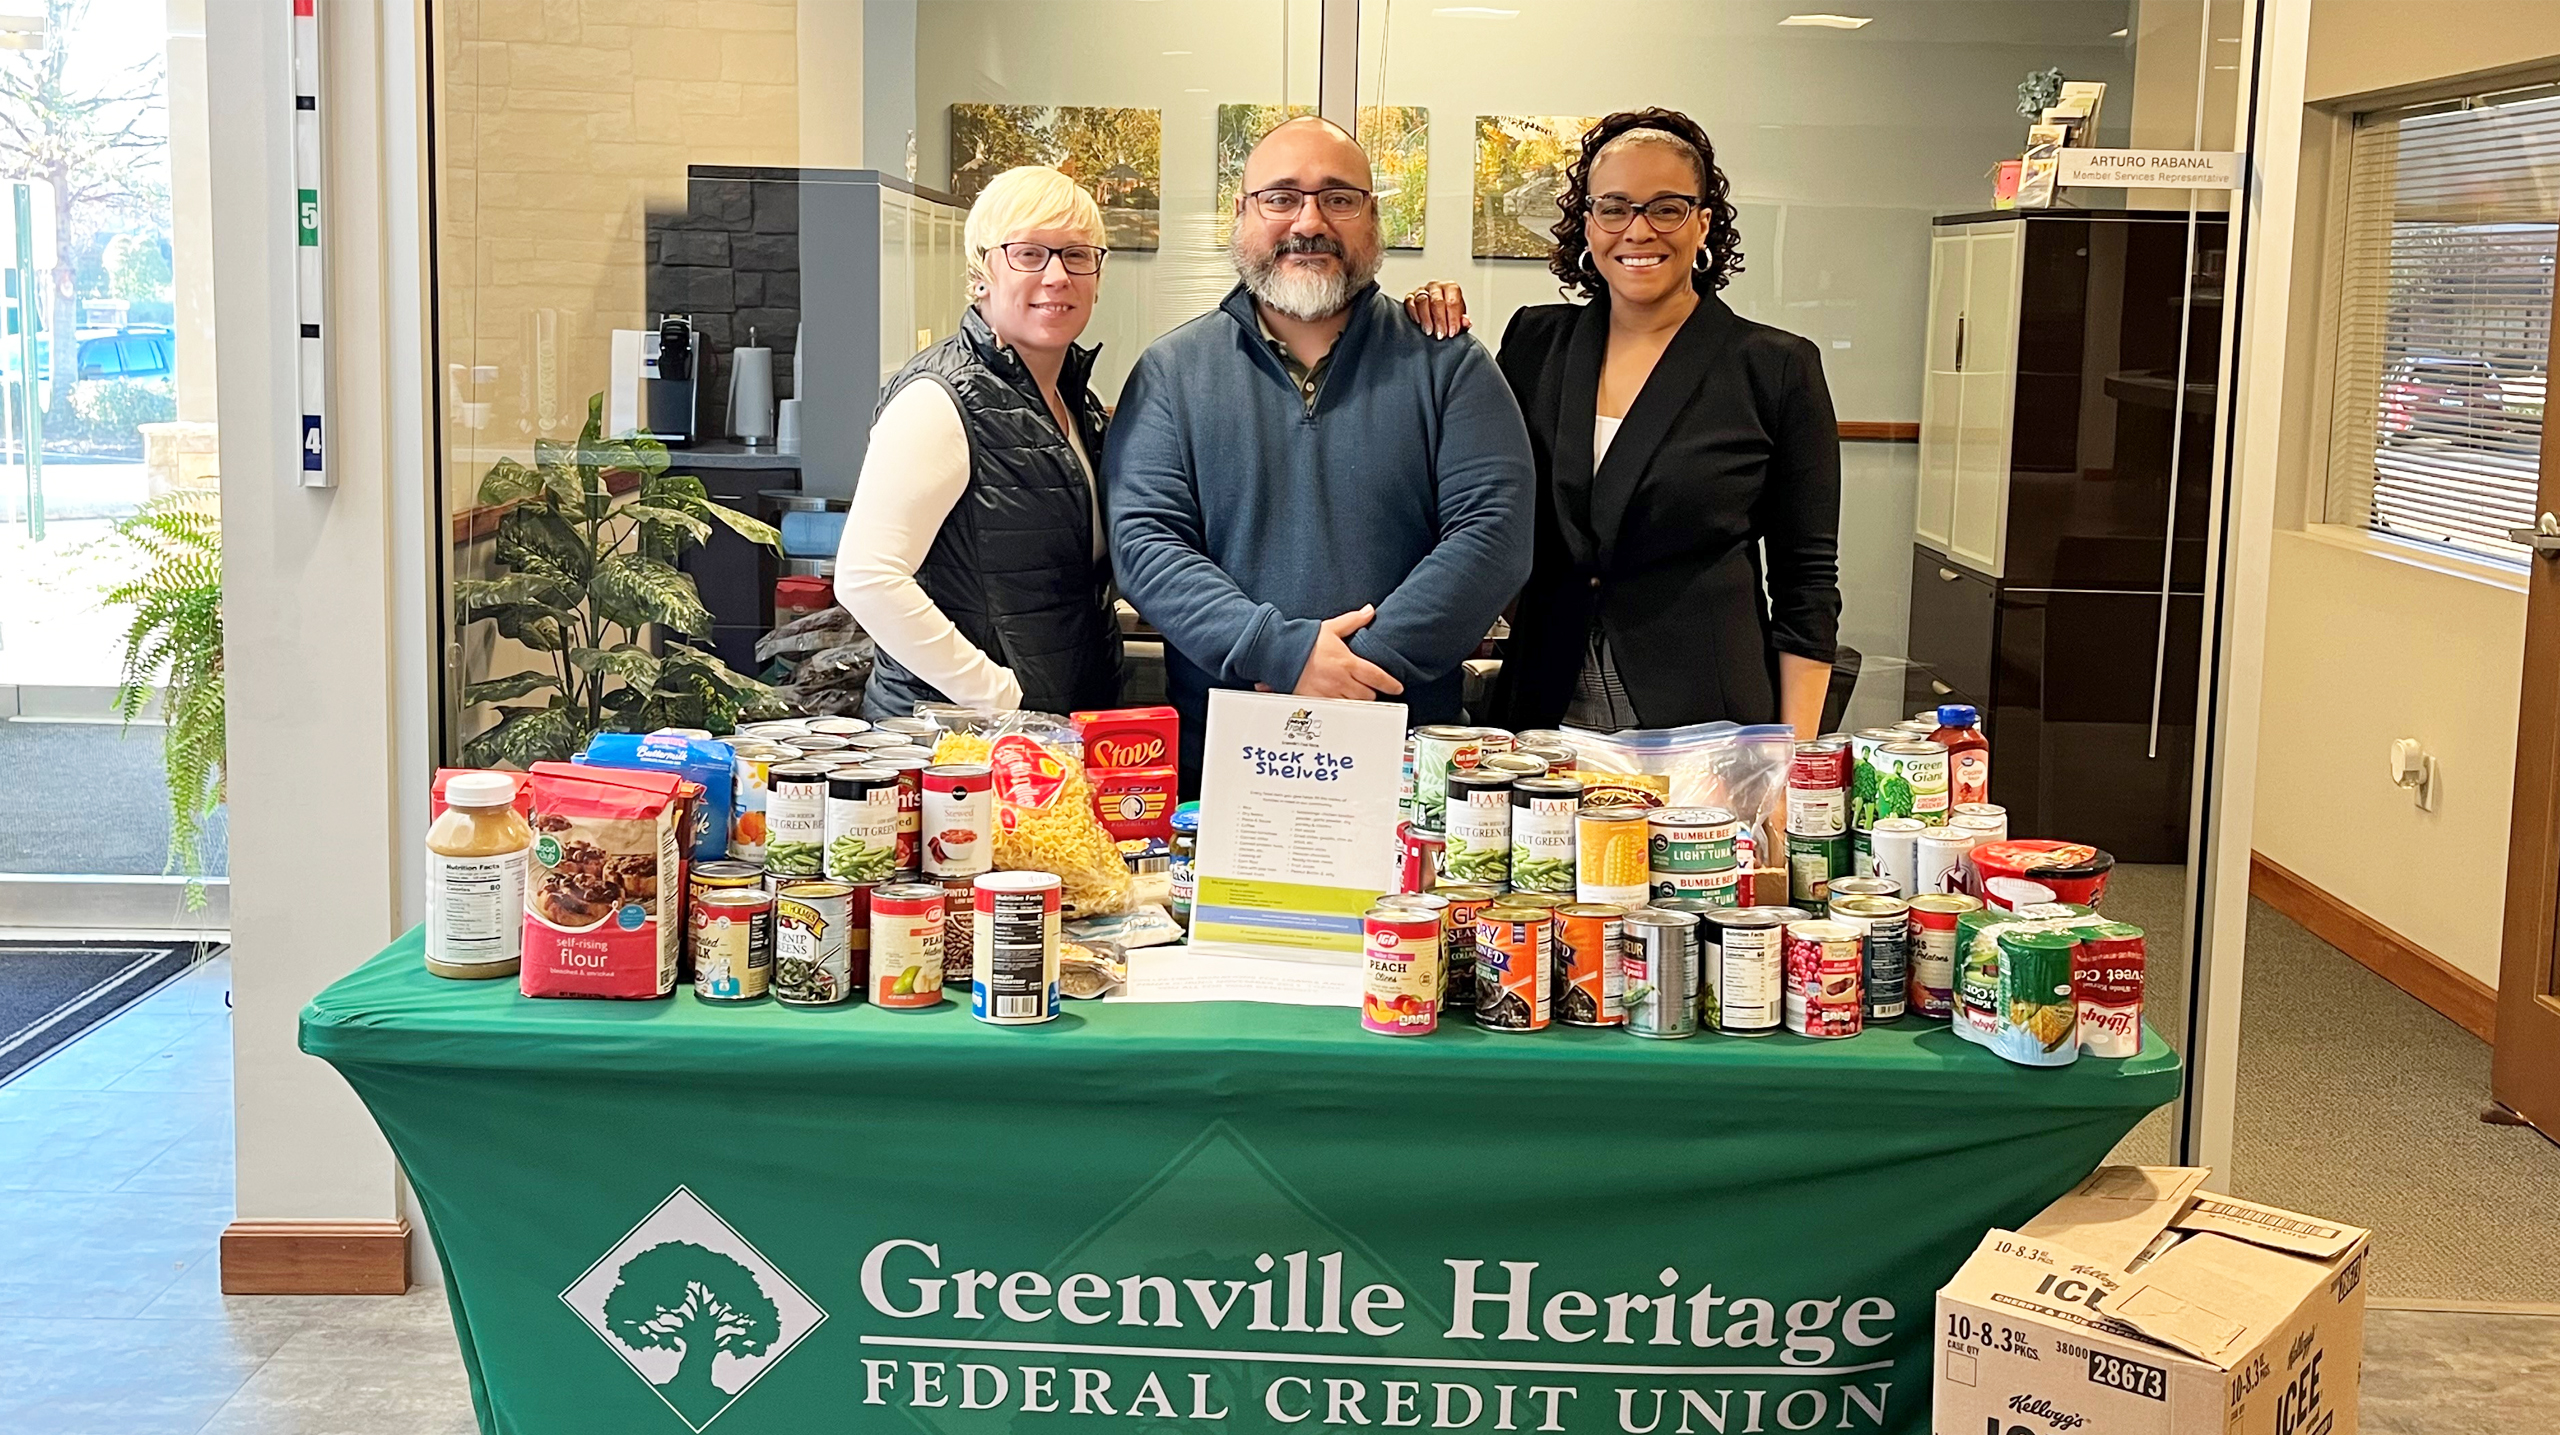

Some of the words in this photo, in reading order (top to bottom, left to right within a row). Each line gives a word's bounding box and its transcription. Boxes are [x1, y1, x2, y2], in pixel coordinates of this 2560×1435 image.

[2090, 156, 2146, 167] ARTURO
[2151, 157, 2214, 169] RABANAL
[2073, 170, 2111, 180] Member
[2114, 171, 2155, 182] Services
[2158, 172, 2230, 183] Representative
[302, 202, 318, 230] 5
[304, 428, 322, 454] 4
[636, 745, 688, 761] Buttermilk
[995, 744, 1026, 766] Egg
[1094, 738, 1165, 768] Stove
[1242, 746, 1304, 764] Stock
[1314, 752, 1354, 770] the
[1466, 754, 1480, 762] Mont
[1256, 762, 1339, 781] Shelves
[1907, 760, 1942, 771] Green
[1008, 761, 1040, 808] Noodles
[1912, 772, 1943, 783] Giant
[779, 784, 824, 796] HART
[1104, 786, 1162, 794] LION
[944, 808, 974, 818] Stewed
[1532, 800, 1577, 812] HART
[780, 820, 810, 830] GREEN
[850, 827, 868, 836] CUT
[1454, 826, 1470, 836] CUT
[1472, 828, 1502, 838] GREEN
[1518, 834, 1534, 844] CUT
[1535, 836, 1566, 846] GREEN
[1673, 830, 1714, 840] BUMBLE
[1716, 828, 1730, 838] BEE
[536, 844, 556, 853] food
[1674, 850, 1706, 860] LIGHT
[1708, 848, 1732, 860] TUNA
[538, 851, 555, 861] club
[1680, 878, 1720, 887] BUMBLE
[1722, 874, 1734, 884] BEE
[1946, 870, 1968, 894] N
[945, 888, 968, 898] PINTO
[1714, 893, 1734, 905] TUNA
[556, 937, 608, 952] self-rising
[1378, 933, 1396, 946] IGA
[560, 948, 608, 968] flour
[1370, 960, 1407, 972] PEACH
[1375, 972, 1398, 982] Slices
[2080, 1008, 2136, 1036] Libby's
[1994, 1240, 2038, 1260] 10-8.3
[860, 1238, 1405, 1336] Greenville
[1443, 1258, 1896, 1366] Heritage
[1994, 1295, 2042, 1312] CHERRY
[2058, 1312, 2088, 1326] BLUE
[1948, 1314, 2012, 1352] 10-8.3
[2014, 1331, 2028, 1344] OZ
[1948, 1340, 1964, 1352] CASE
[1966, 1345, 1980, 1356] QTY
[2056, 1340, 2088, 1360] 38000
[2093, 1354, 2162, 1398] 28673
[2231, 1359, 2260, 1407] 10-8.3
[860, 1358, 1228, 1420] FEDERAL
[1265, 1376, 1577, 1430] CREDIT
[1614, 1382, 1892, 1434] UNION
[2276, 1348, 2324, 1435] ICEE
[2008, 1394, 2084, 1430] Kellogg's
